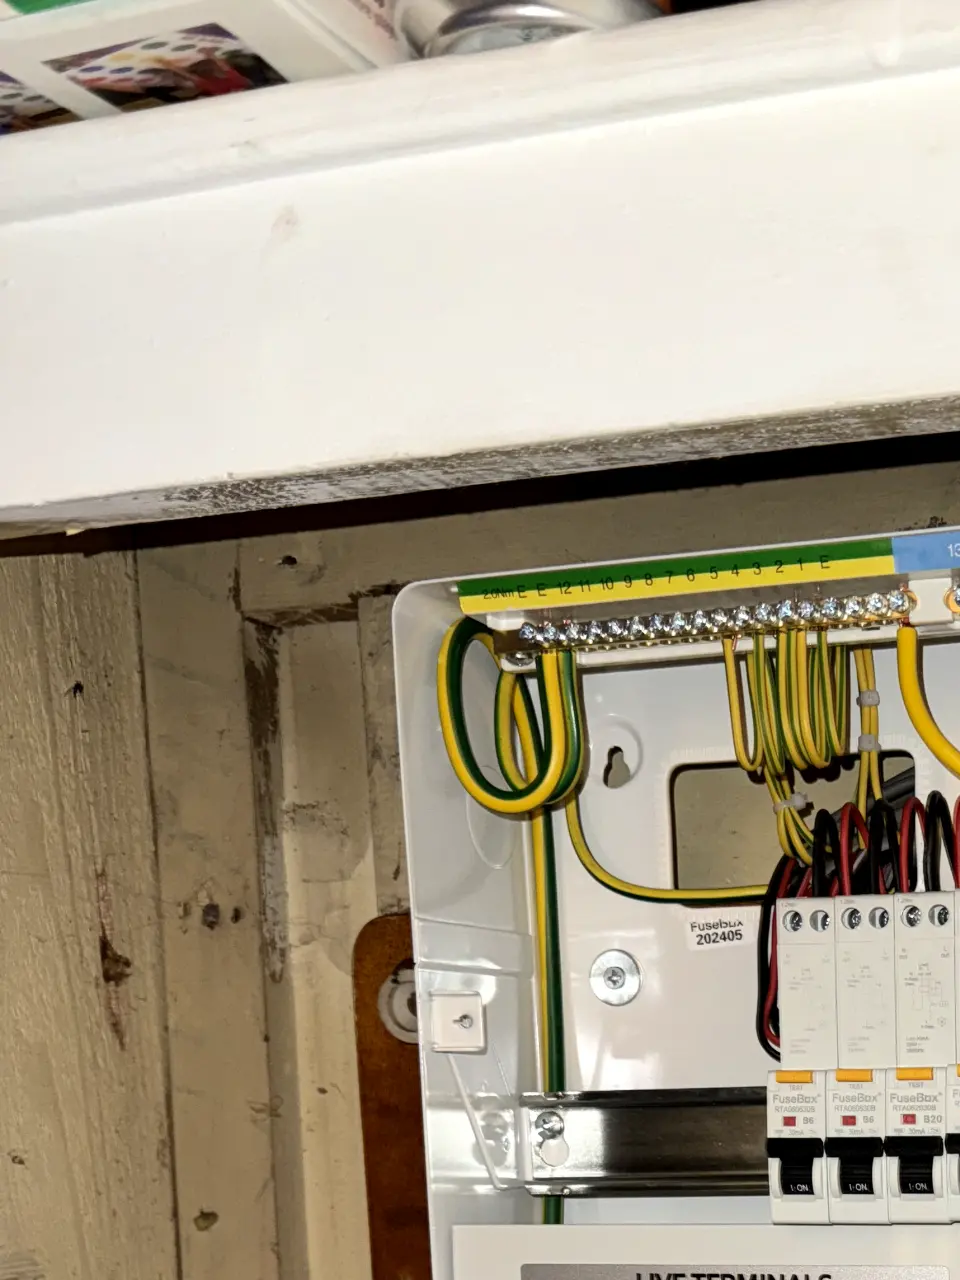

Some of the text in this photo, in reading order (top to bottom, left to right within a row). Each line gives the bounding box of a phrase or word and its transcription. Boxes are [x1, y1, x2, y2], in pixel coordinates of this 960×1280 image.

[517, 585, 527, 598] E
[537, 583, 547, 596] E
[558, 581, 572, 594] 12
[579, 580, 591, 592] 11
[601, 577, 614, 590] 10
[624, 575, 632, 588] 9
[645, 573, 653, 586] 8
[665, 571, 674, 584] 7
[686, 569, 695, 582] 6
[710, 566, 719, 579] 5
[731, 564, 740, 577] 4
[752, 562, 761, 575] 3
[775, 560, 784, 573] 2
[797, 557, 803, 571] 1
[819, 555, 830, 569] E
[696, 929, 743, 945] 202405
[863, 1116, 874, 1124] B6
[923, 1115, 942, 1124] B20
